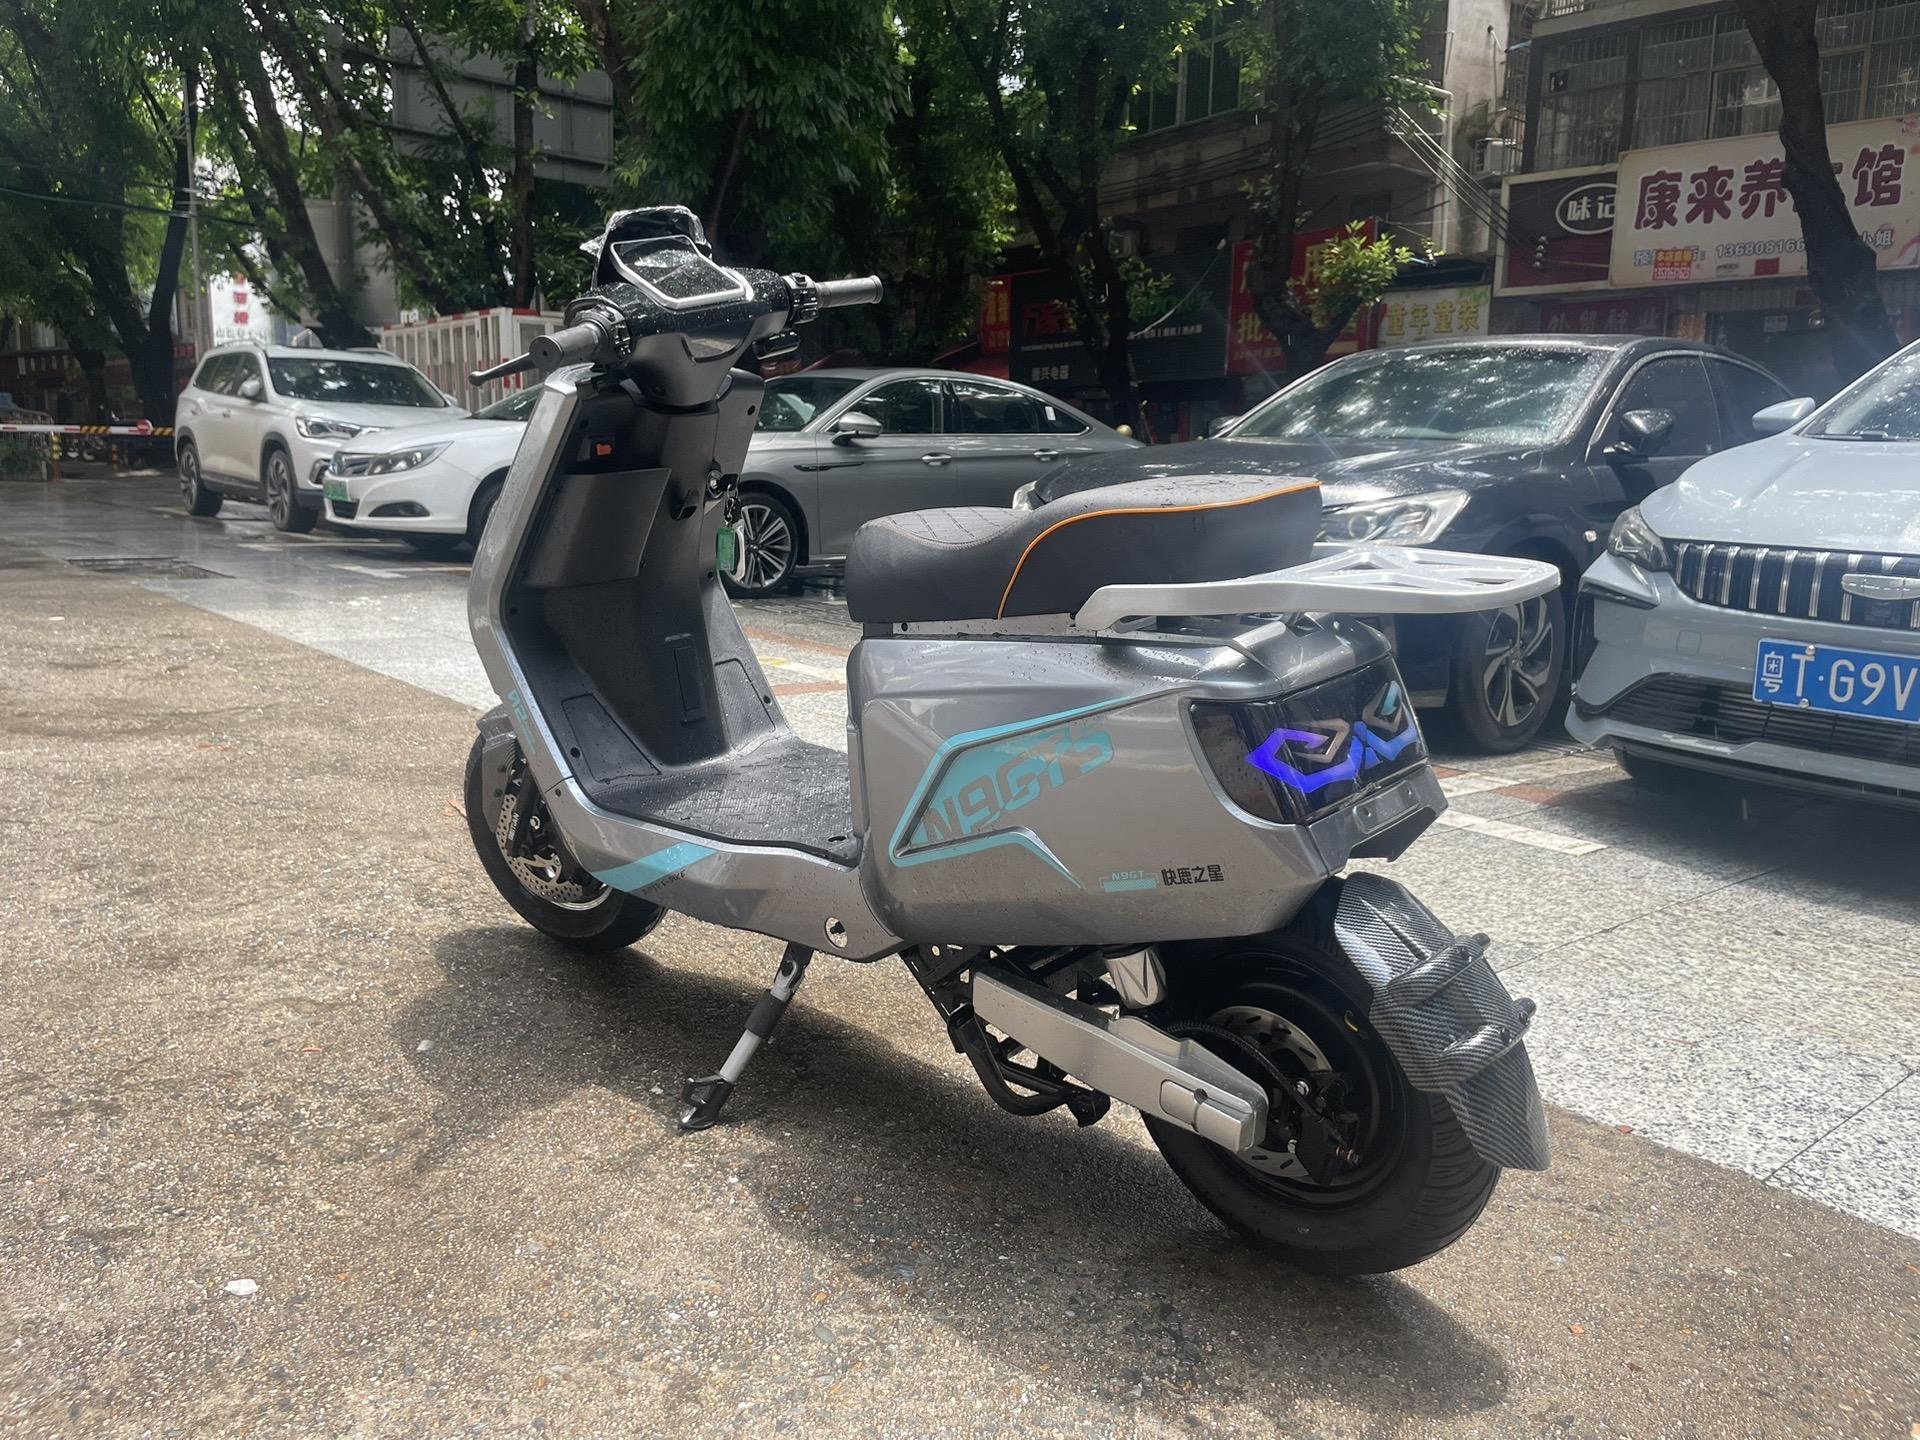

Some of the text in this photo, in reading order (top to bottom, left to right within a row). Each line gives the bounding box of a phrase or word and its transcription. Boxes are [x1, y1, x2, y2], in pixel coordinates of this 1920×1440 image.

[1634, 144, 1905, 230] 康来养馆
[1386, 299, 1480, 336] 童年童装
[1111, 870, 1145, 881] N9GT
[1161, 864, 1225, 886] 快鹿之星
